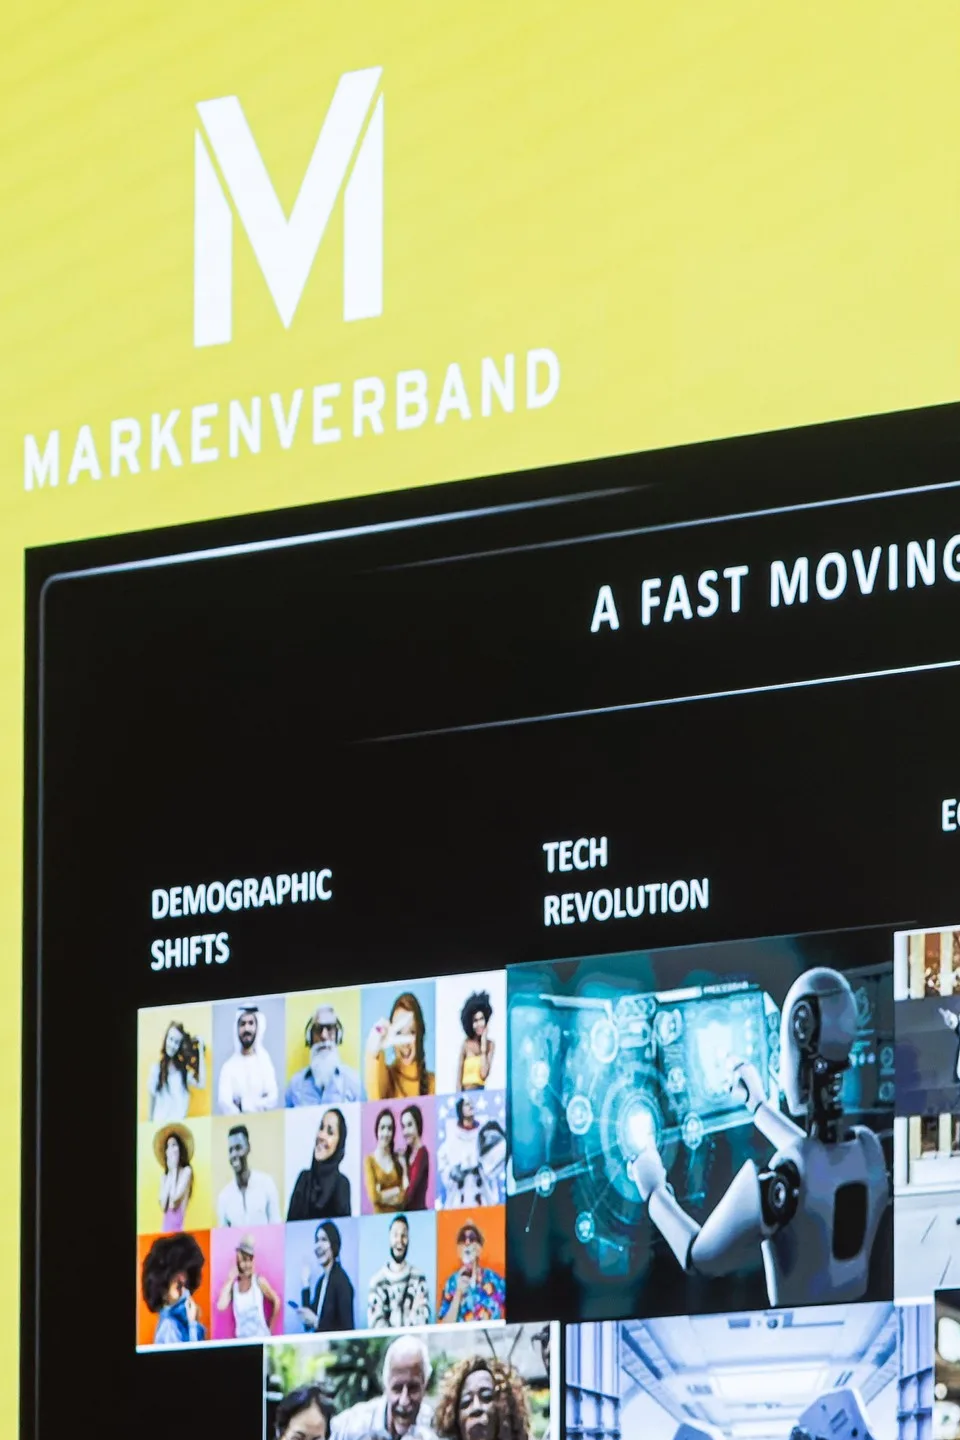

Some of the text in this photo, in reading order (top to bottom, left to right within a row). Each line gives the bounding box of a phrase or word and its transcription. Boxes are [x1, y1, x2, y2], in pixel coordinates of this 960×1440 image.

[194, 66, 384, 347] M
[23, 347, 561, 491] MARKENVERBAND
[590, 584, 620, 633] A
[641, 565, 749, 626] FAST
[542, 836, 608, 873] TECH
[151, 868, 333, 920] DEMOGRAPHIC
[543, 877, 709, 927] REVOLUTION
[150, 931, 230, 971] SHIFTS
